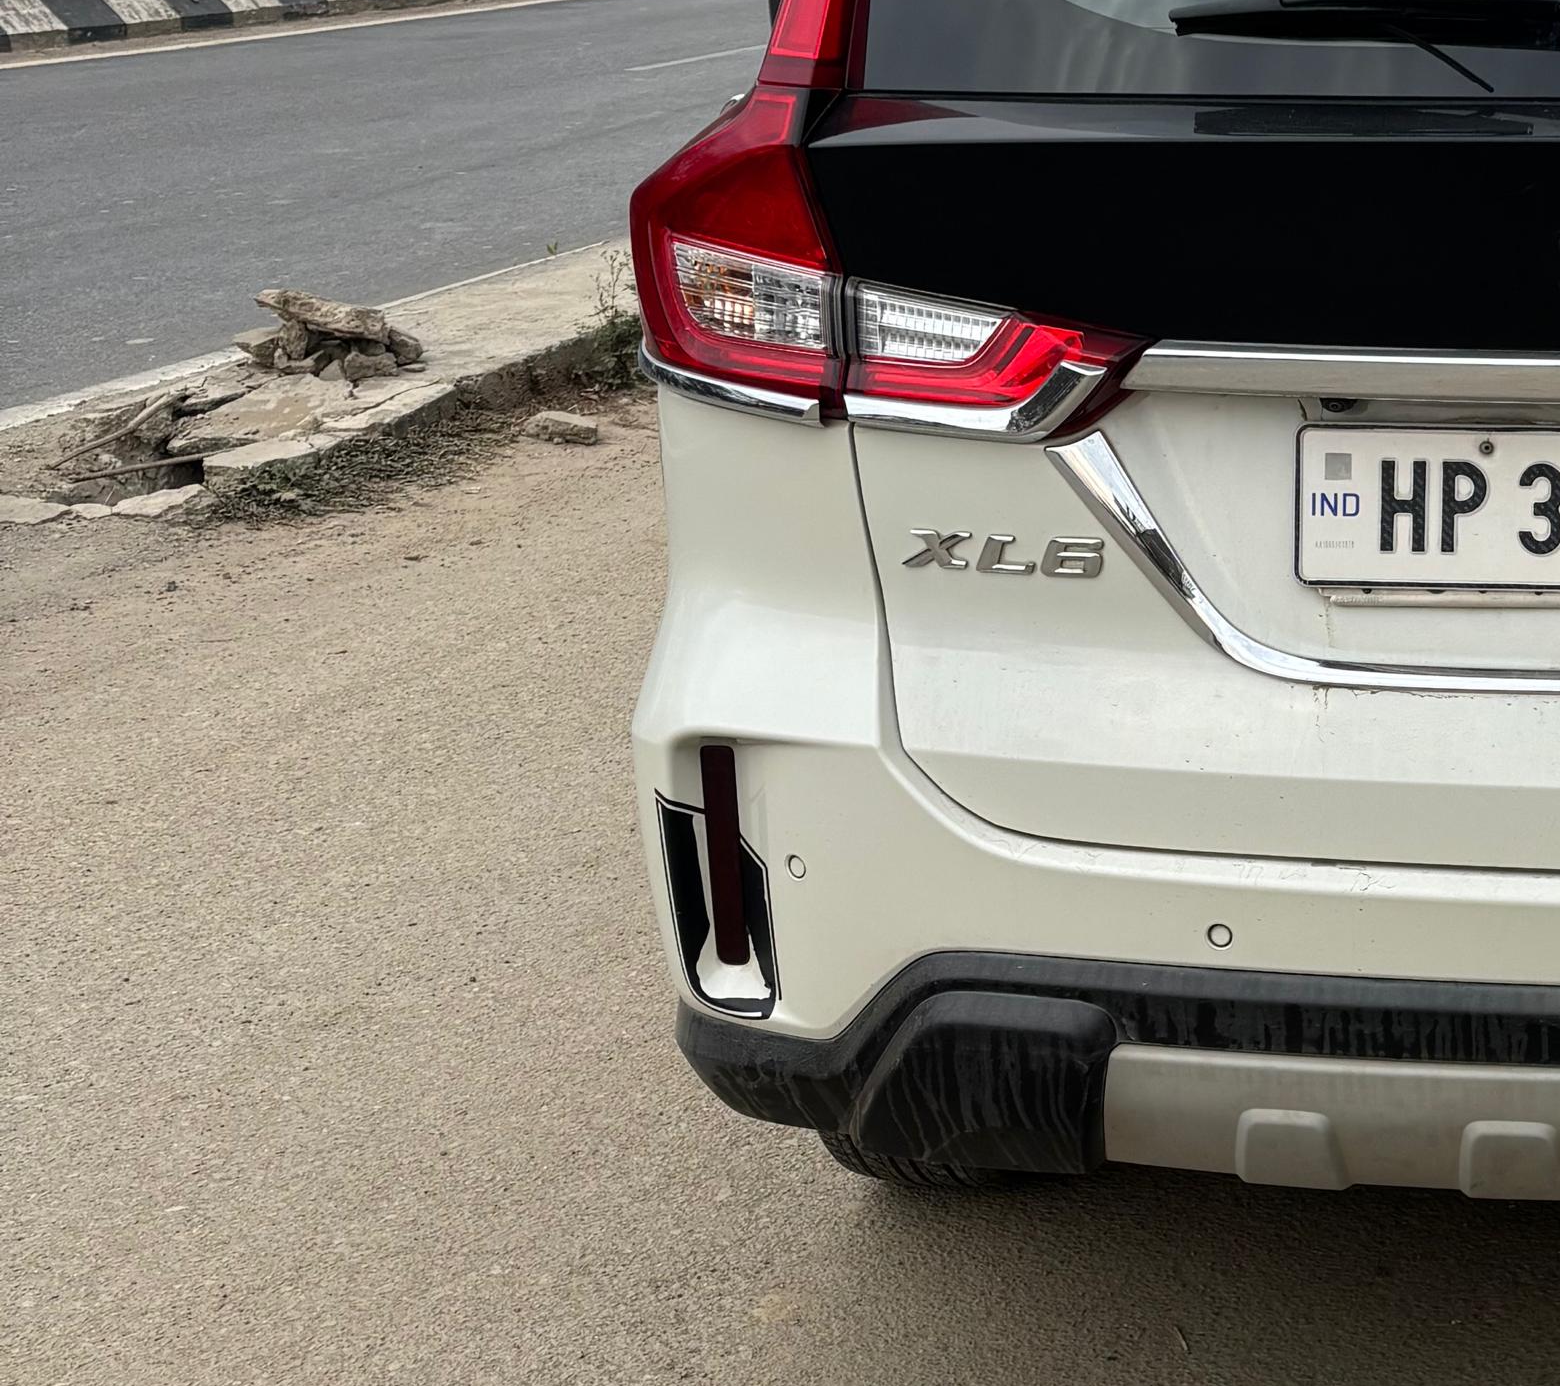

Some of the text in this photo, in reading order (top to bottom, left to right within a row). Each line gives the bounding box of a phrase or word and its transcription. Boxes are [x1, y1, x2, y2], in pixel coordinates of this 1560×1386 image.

[1311, 492, 1360, 517] IND
[1379, 459, 1489, 554] HP
[901, 528, 1105, 579] XL6
